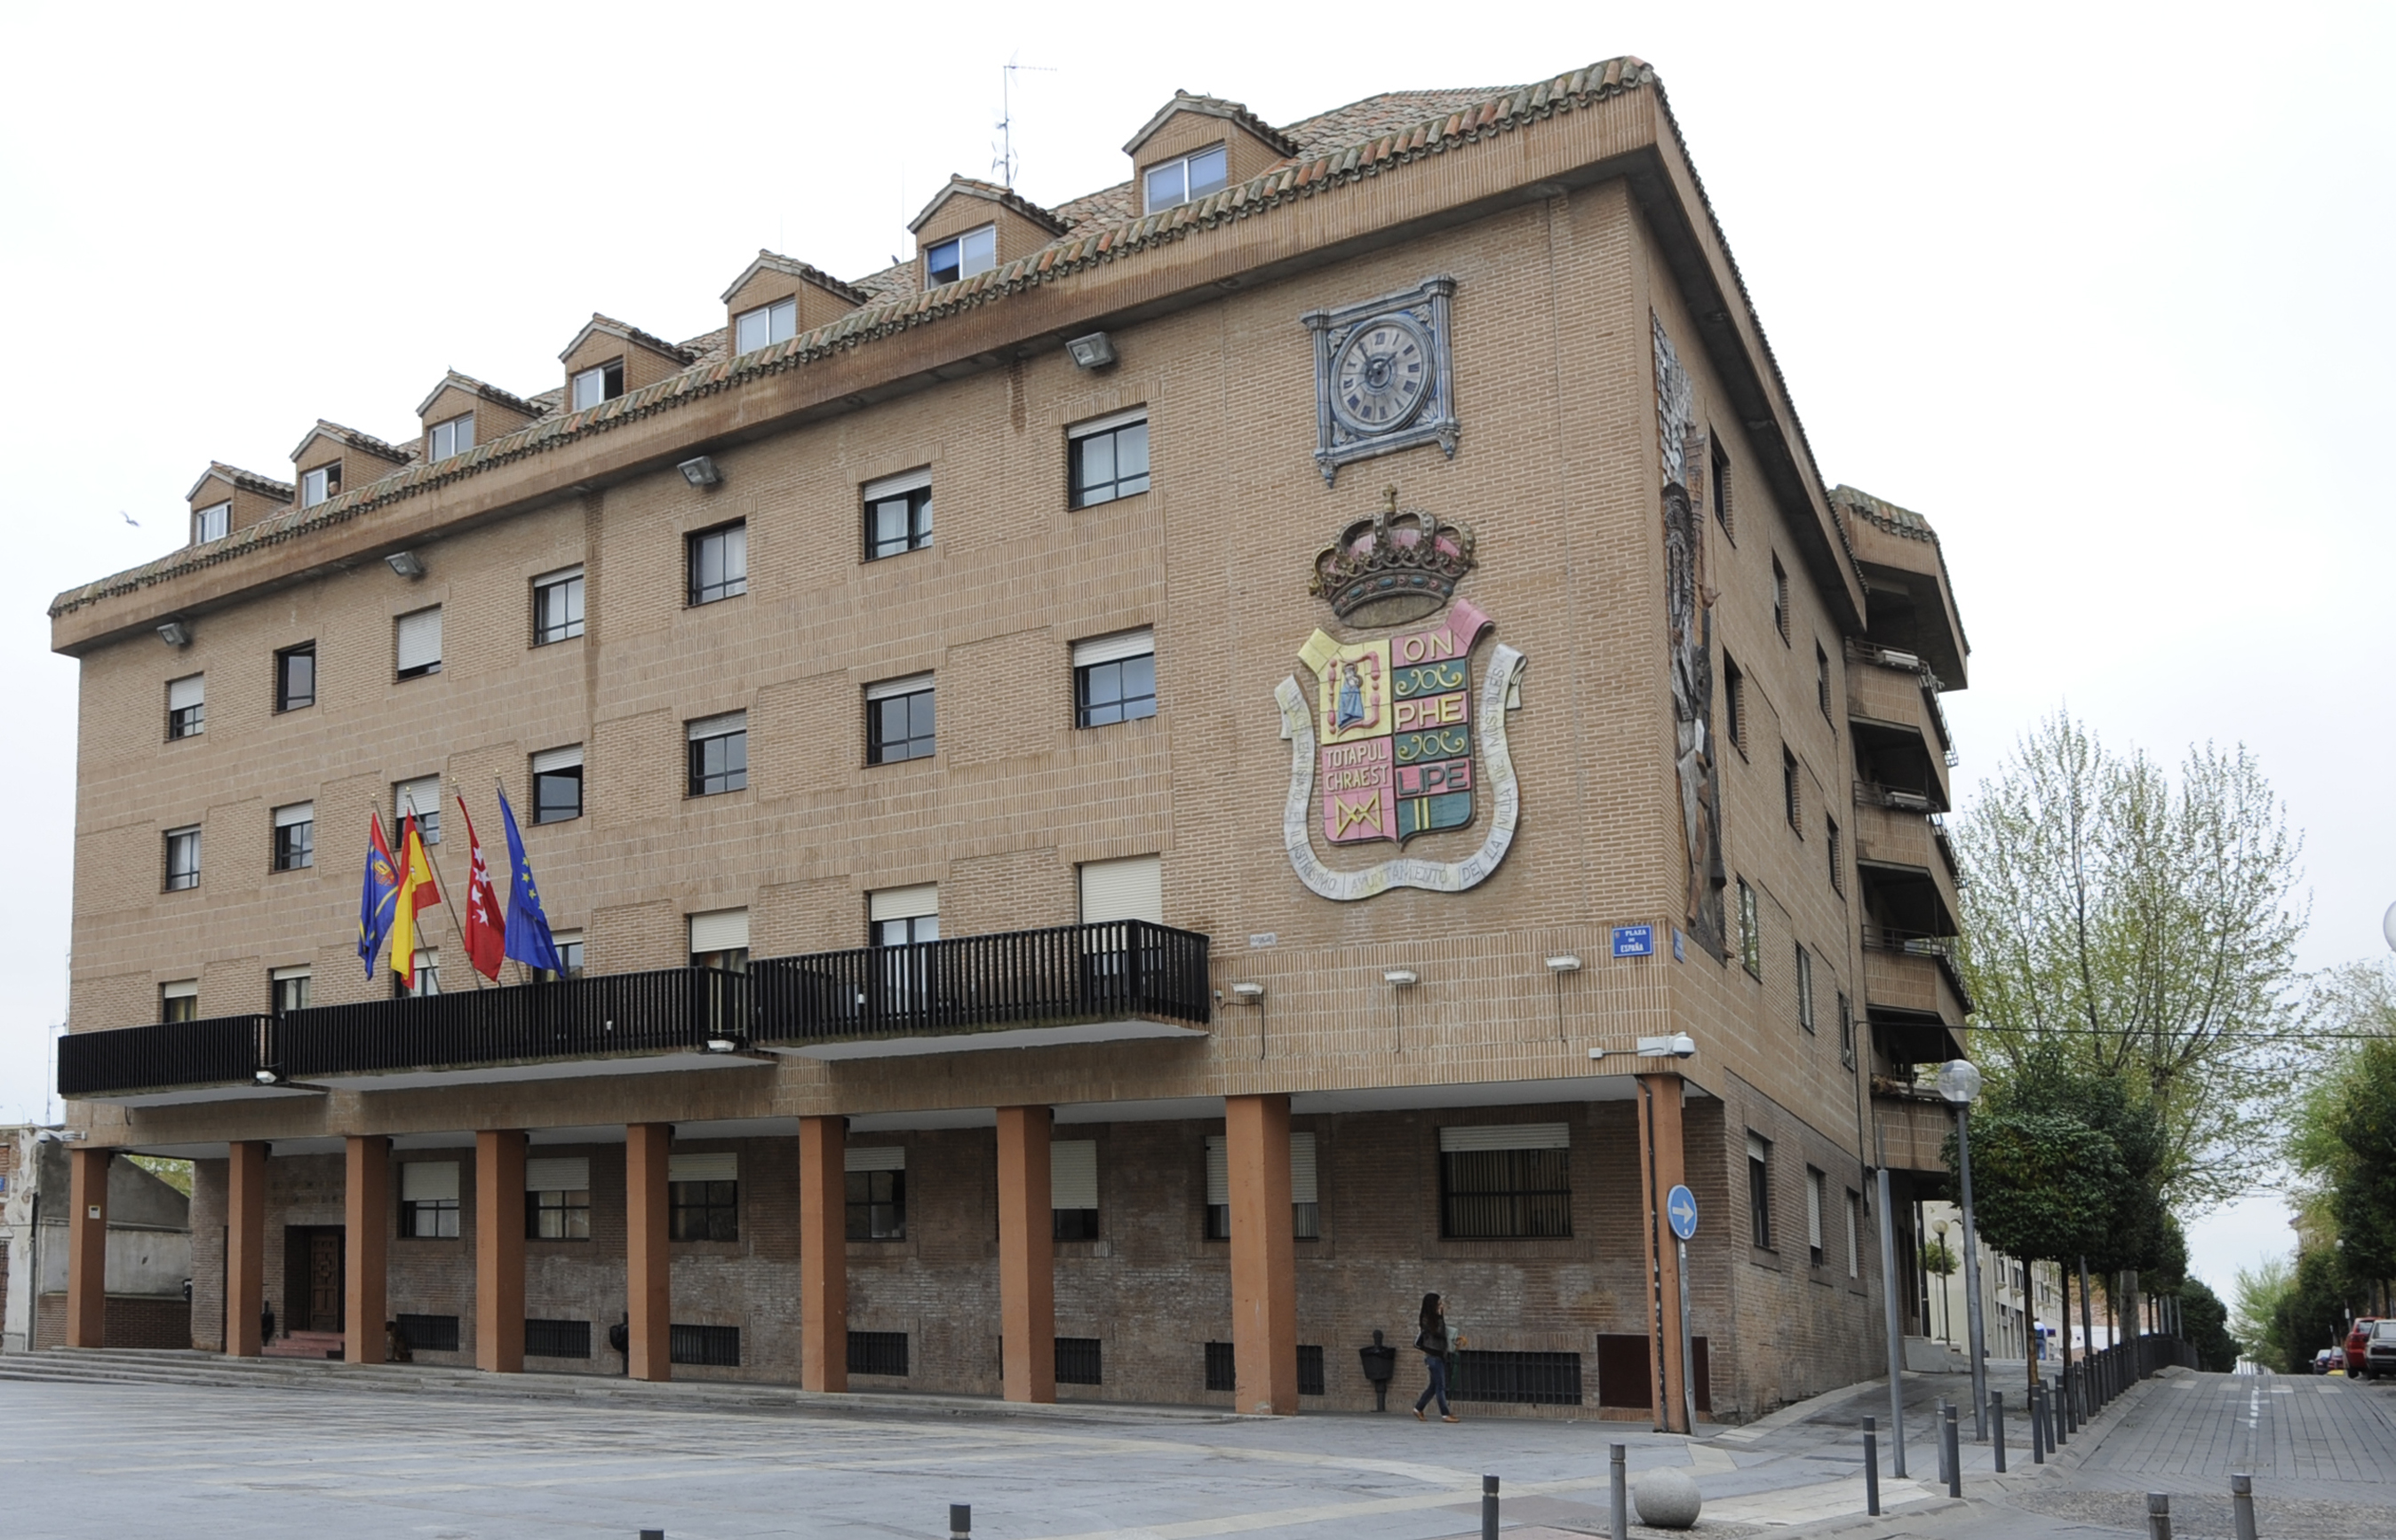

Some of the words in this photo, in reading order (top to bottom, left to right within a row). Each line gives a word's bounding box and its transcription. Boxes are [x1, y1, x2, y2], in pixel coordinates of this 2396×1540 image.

[1403, 630, 1454, 663] ON
[1396, 695, 1464, 730] PHE
[1397, 762, 1467, 796] LIPE
[1351, 863, 1448, 893] AYUNTAMIENTO
[1462, 861, 1480, 882] DE
[1620, 942, 1644, 953] ESPAÑA
